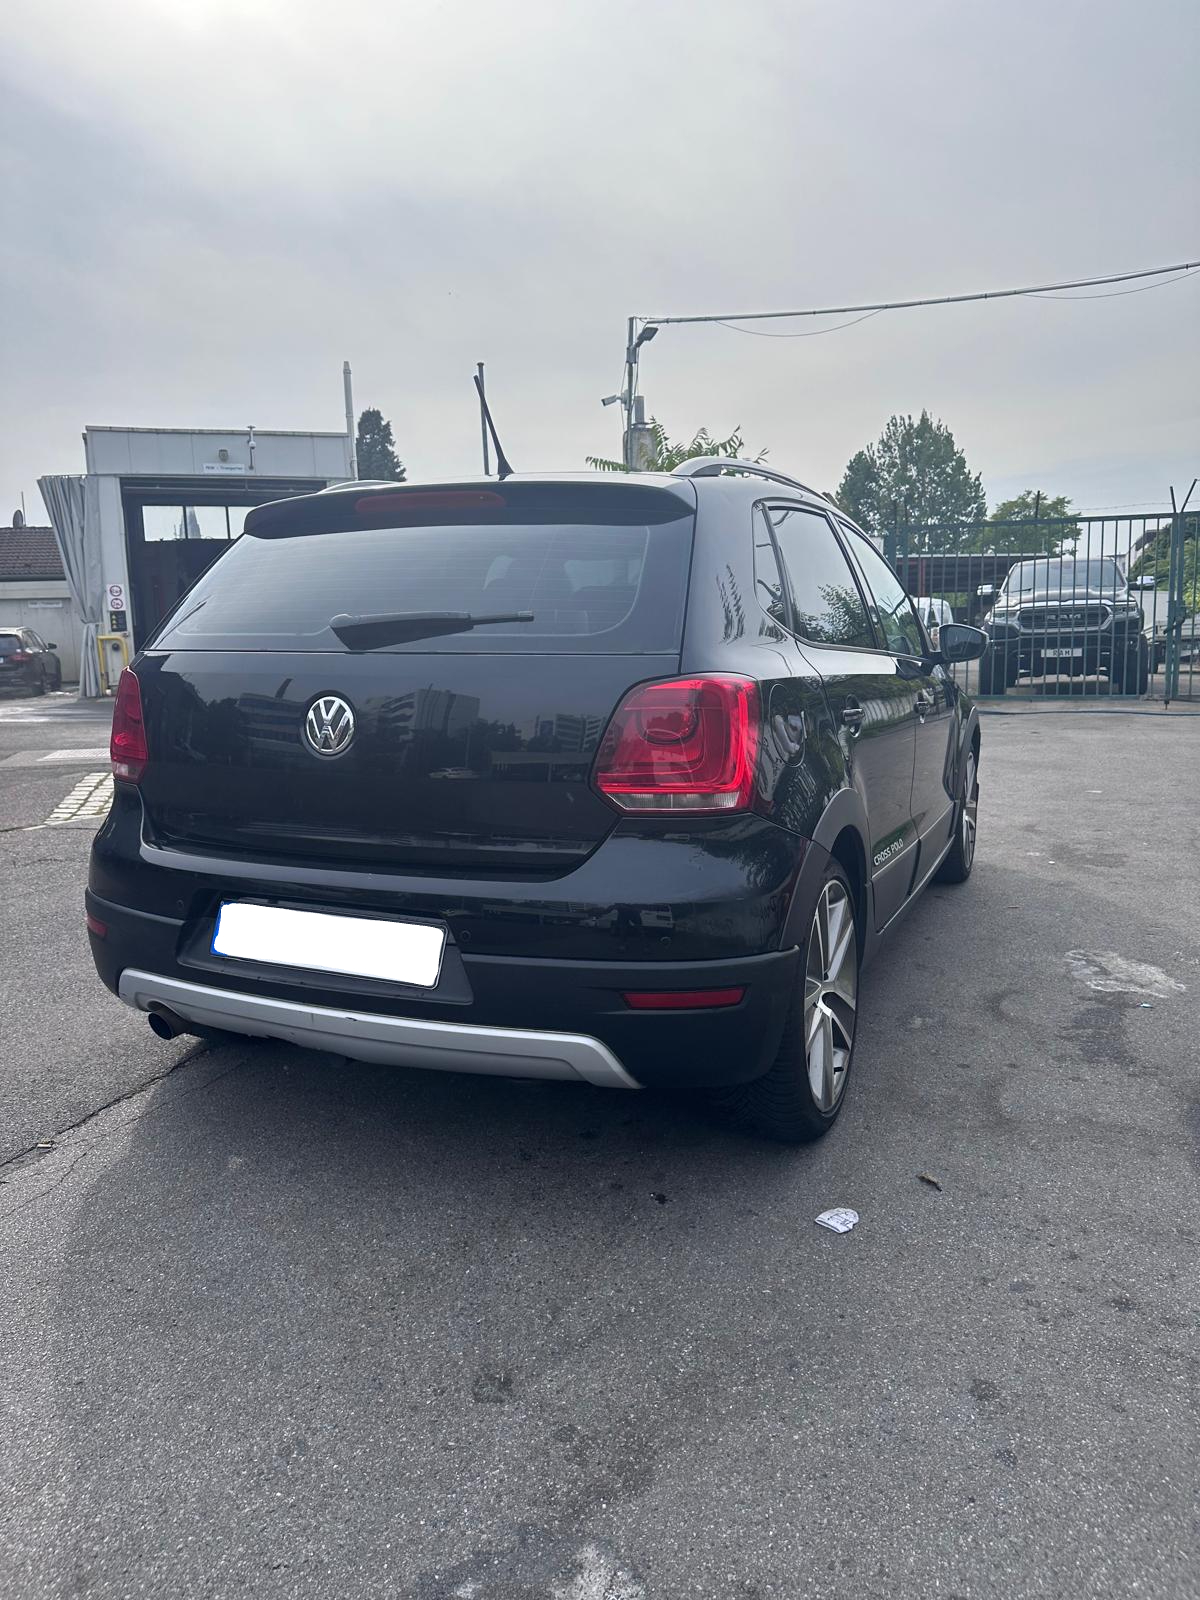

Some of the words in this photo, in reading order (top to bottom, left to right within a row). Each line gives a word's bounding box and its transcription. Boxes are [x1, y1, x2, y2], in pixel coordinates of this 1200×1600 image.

[306, 696, 354, 755] VW
[873, 846, 892, 866] CROSS
[890, 838, 904, 854] POLO
